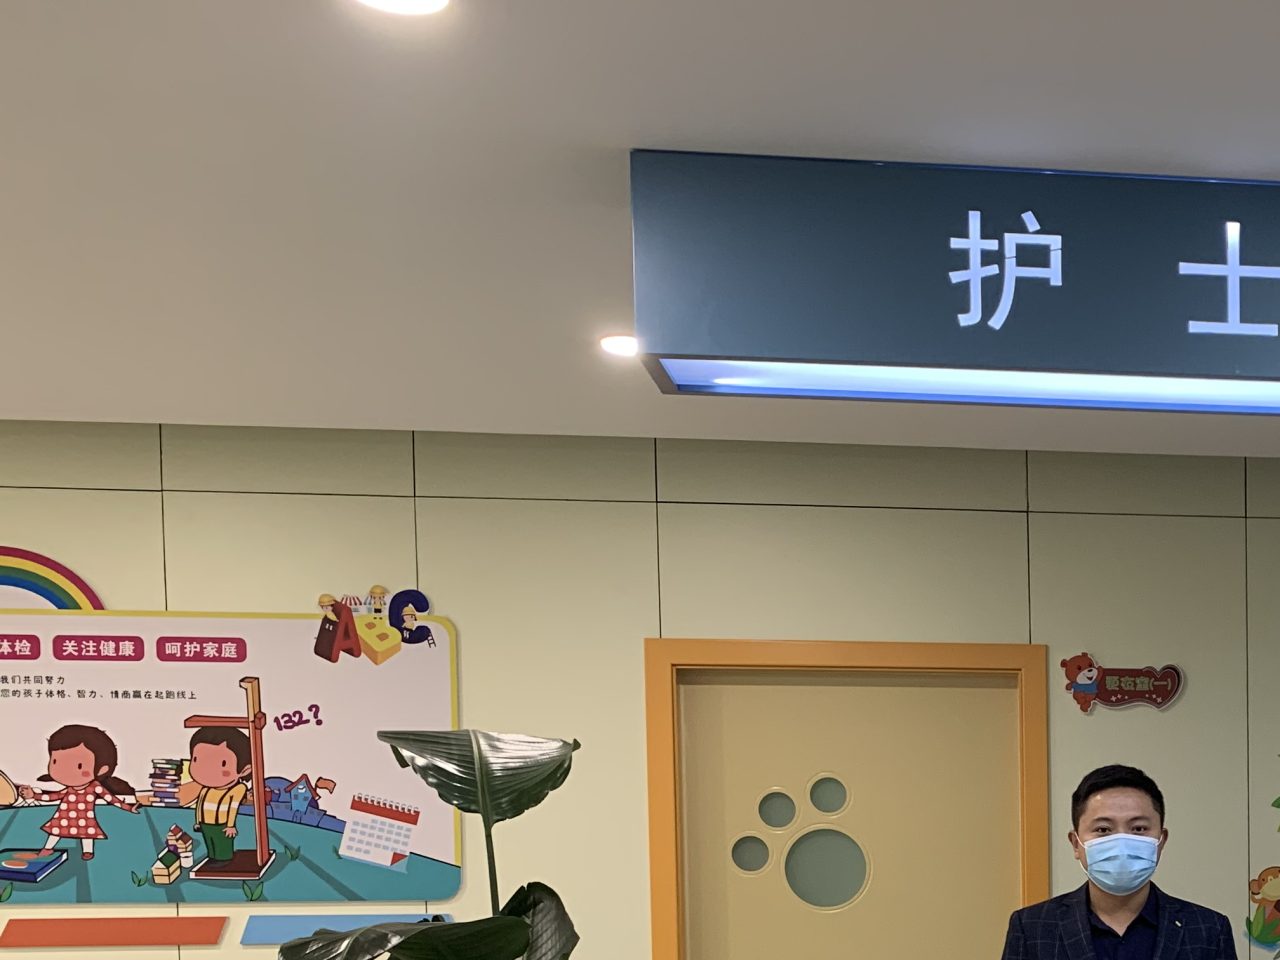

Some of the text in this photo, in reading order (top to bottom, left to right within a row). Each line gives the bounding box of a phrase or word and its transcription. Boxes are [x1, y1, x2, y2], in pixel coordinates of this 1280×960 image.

[62, 639, 136, 657] 关注健康
[164, 640, 238, 658] 呵护家庭
[0, 675, 65, 685] 我们共同努力
[273, 704, 323, 731] 132?
